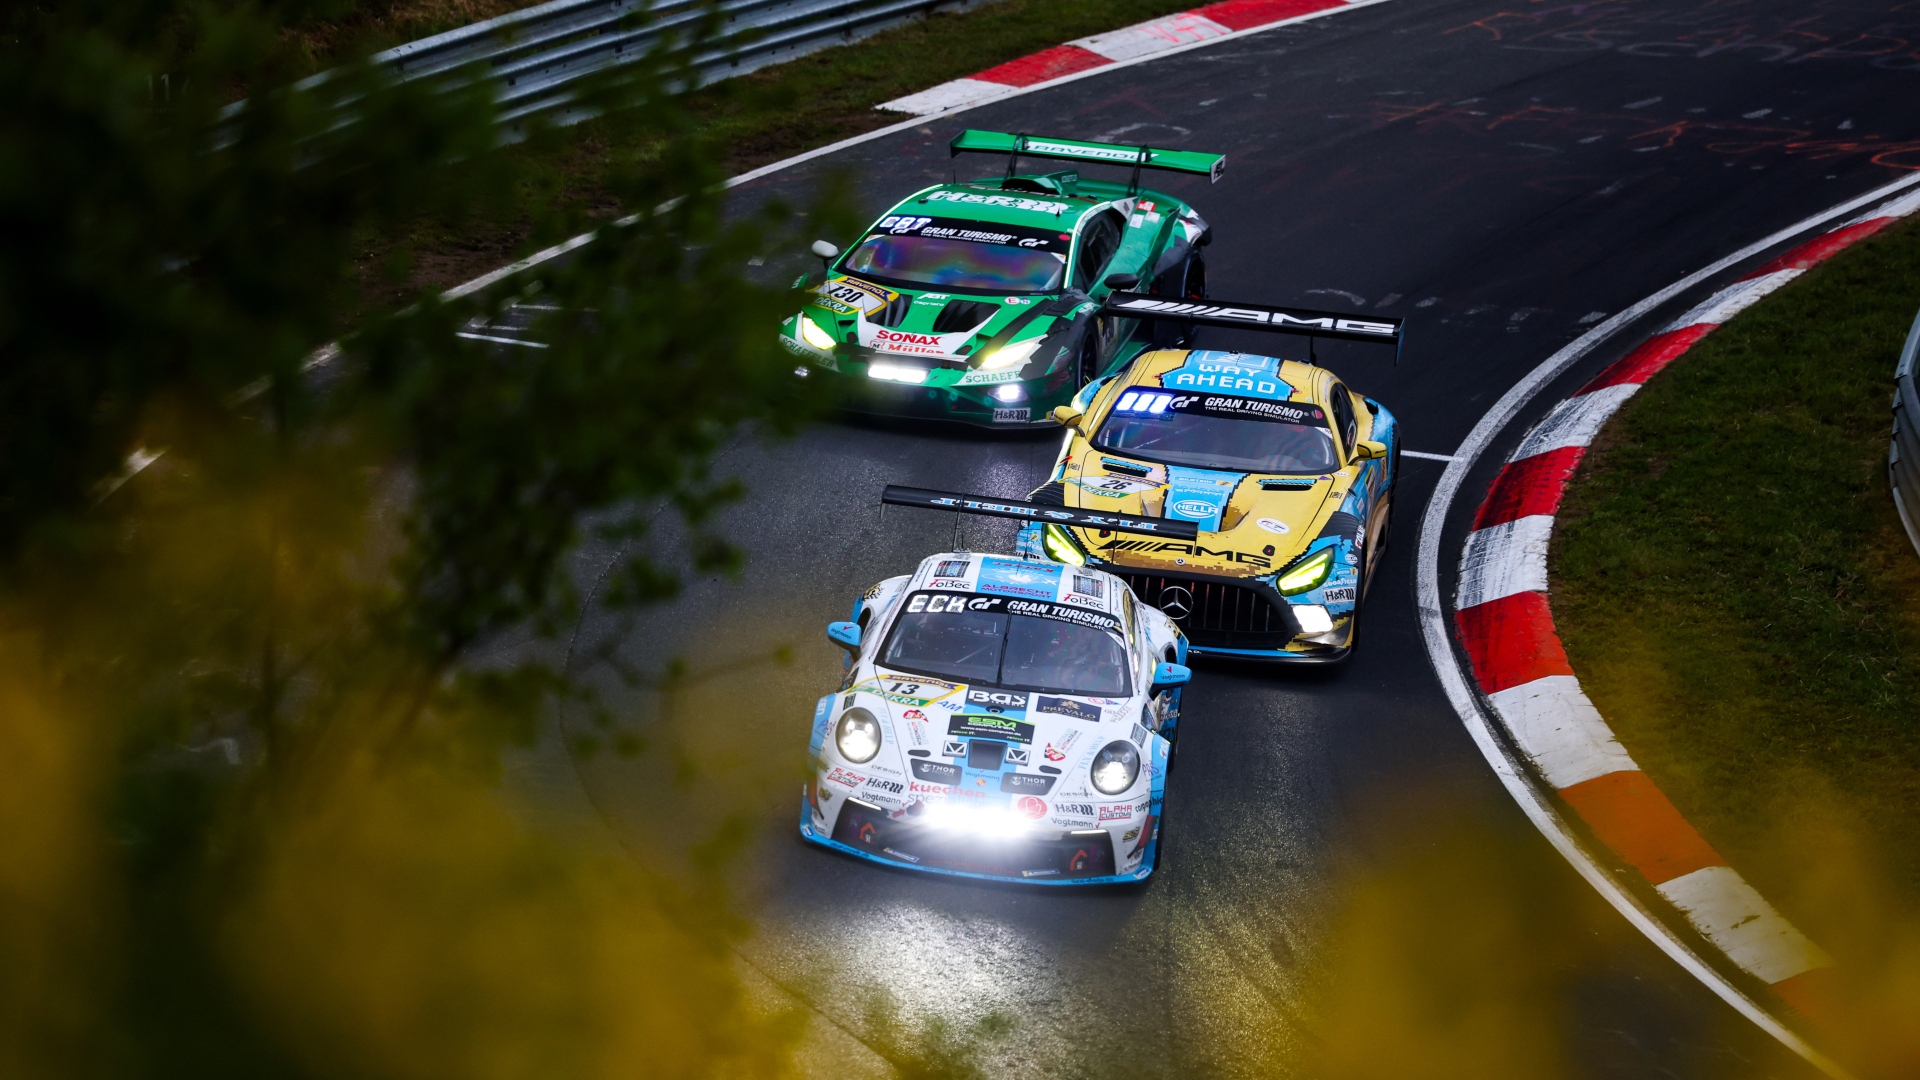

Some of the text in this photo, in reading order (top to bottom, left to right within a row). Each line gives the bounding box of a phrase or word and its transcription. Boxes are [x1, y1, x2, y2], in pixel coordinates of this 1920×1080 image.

[921, 226, 1013, 241] GRAN TURISMO
[846, 277, 886, 297] RAVENOL
[827, 285, 864, 303] 130
[814, 296, 849, 313] DEKRA
[1203, 307, 1395, 334] AMG
[876, 330, 942, 345] SONAX
[1198, 363, 1263, 377] WAY
[1176, 373, 1277, 394] AHEAD
[995, 410, 1016, 420] H&R
[1204, 397, 1303, 420] GRAN TURISMO
[1236, 408, 1262, 417] DRIVING
[1263, 411, 1300, 424] SIMULATOR
[1100, 479, 1132, 490] 26
[1081, 485, 1120, 498] DEKRA
[930, 497, 1037, 516] HELP
[1177, 503, 1219, 515] HELLA
[1081, 515, 1158, 531] FLY
[1152, 543, 1271, 568] AMG
[981, 583, 1052, 595] ALBRECHT
[1324, 590, 1346, 601] H&R
[906, 594, 966, 613] ECK
[1007, 600, 1115, 628] GRAN TURISMO
[1042, 613, 1071, 622] DRIVING
[889, 682, 920, 695] 13
[872, 689, 920, 706] DEKRA
[936, 700, 963, 712] AM
[1042, 706, 1096, 719] PREVALO
[932, 764, 956, 773] THOR
[965, 771, 1000, 781] Vogtmann
[866, 777, 890, 790] H&R
[909, 781, 986, 799] kuechen
[861, 791, 902, 804] Vogtmann
[1055, 803, 1080, 814] H&R
[1100, 804, 1133, 813] ALPHA
[1051, 817, 1094, 829] Vogtmann
